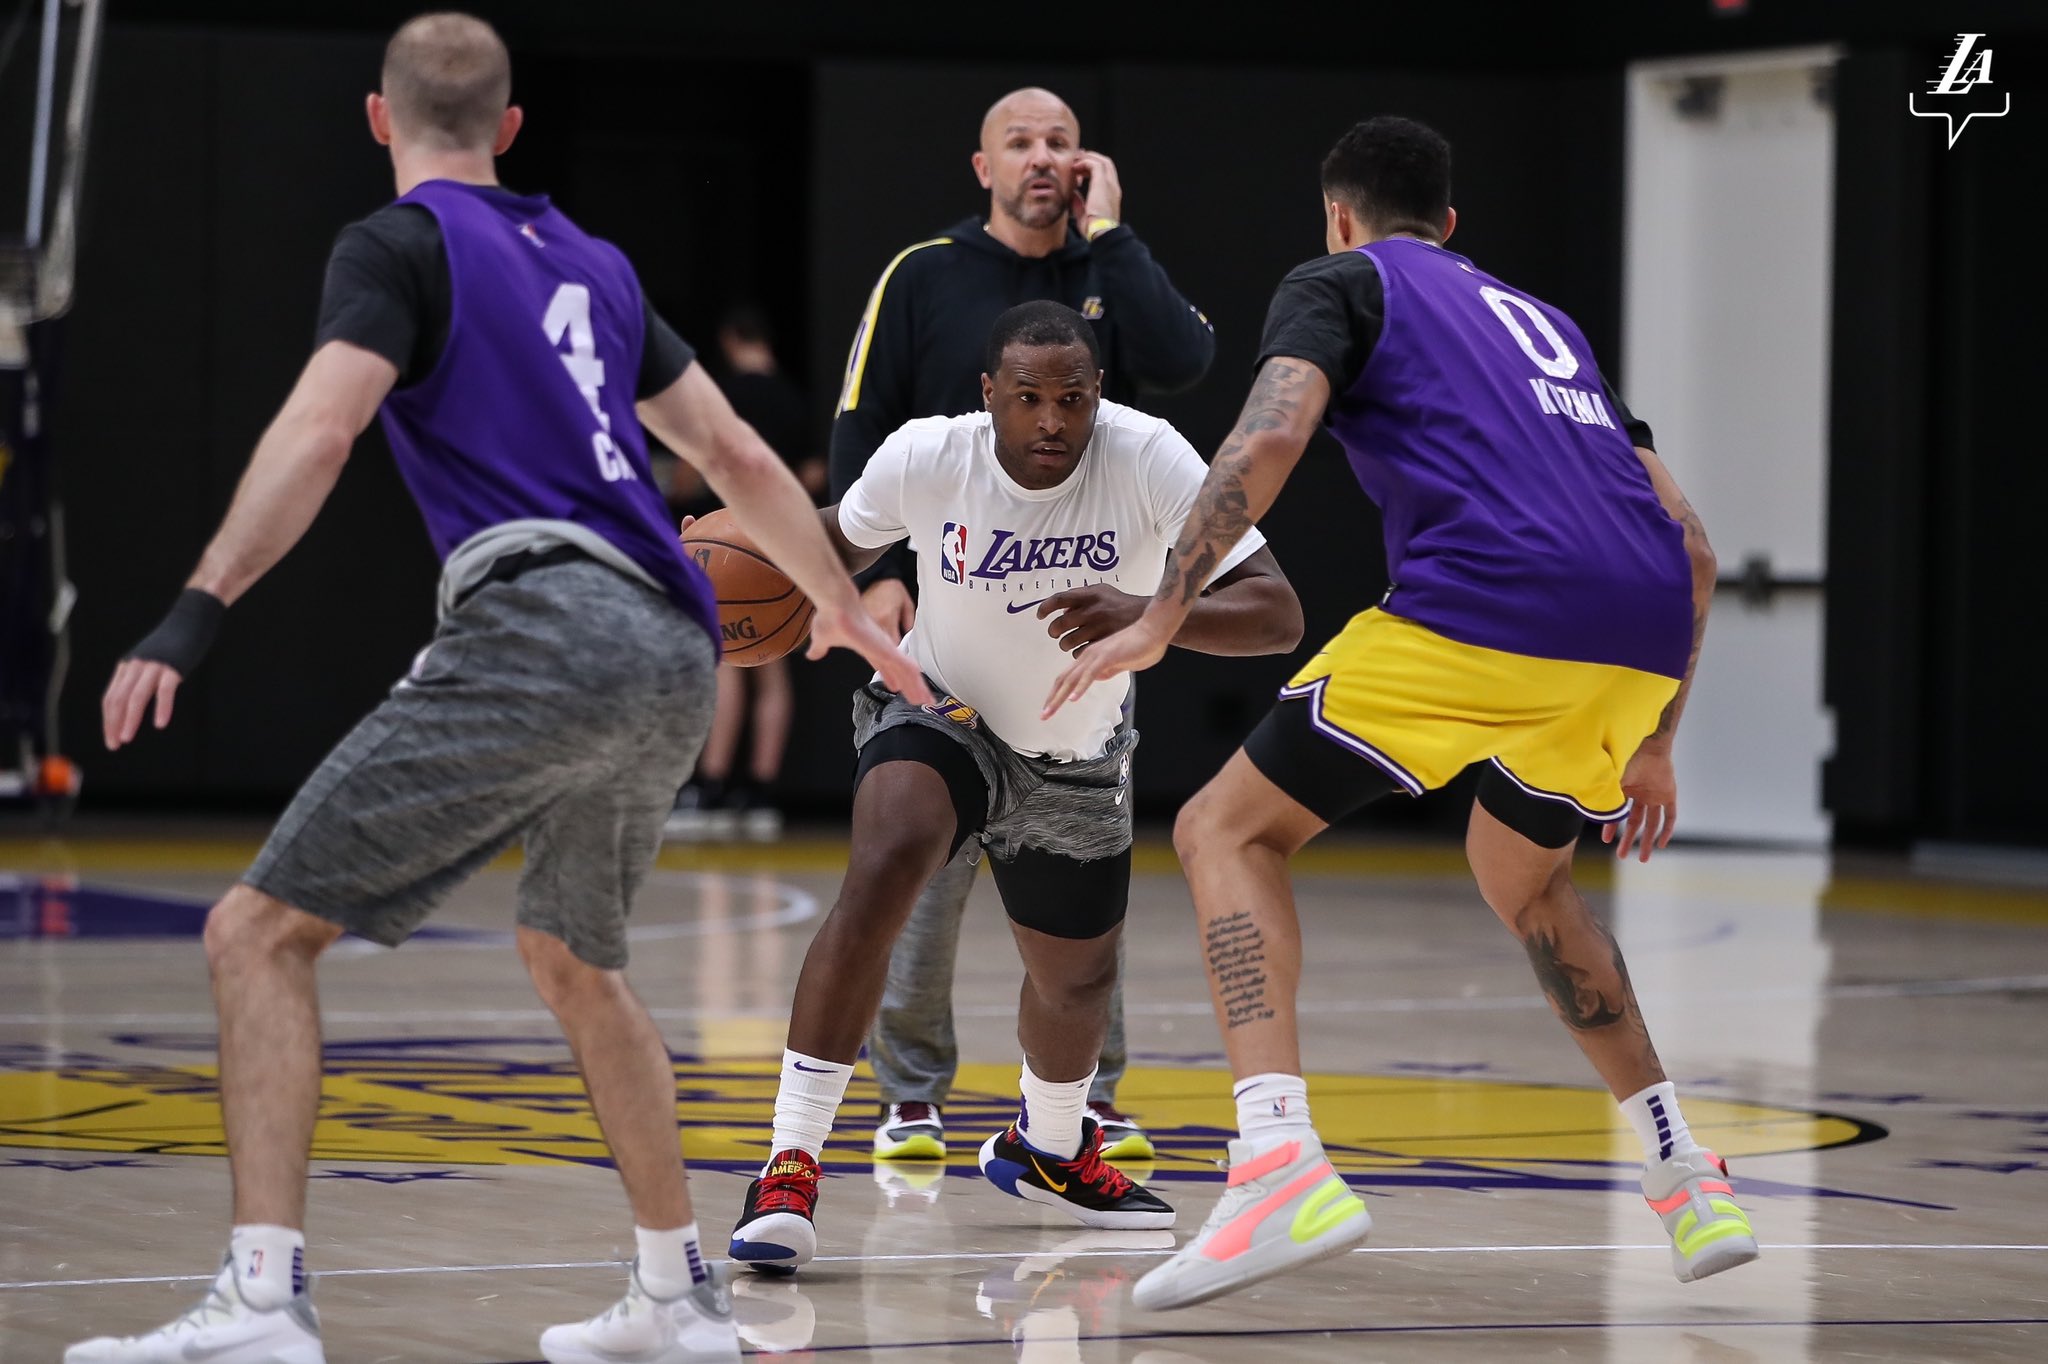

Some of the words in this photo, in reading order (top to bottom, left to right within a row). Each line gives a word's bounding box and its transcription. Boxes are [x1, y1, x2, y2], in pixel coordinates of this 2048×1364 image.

[1479, 285, 1580, 380] 0
[1528, 378, 1617, 431] KUZMA
[943, 567, 956, 581] NBA
[968, 529, 1120, 580] LAKERS
